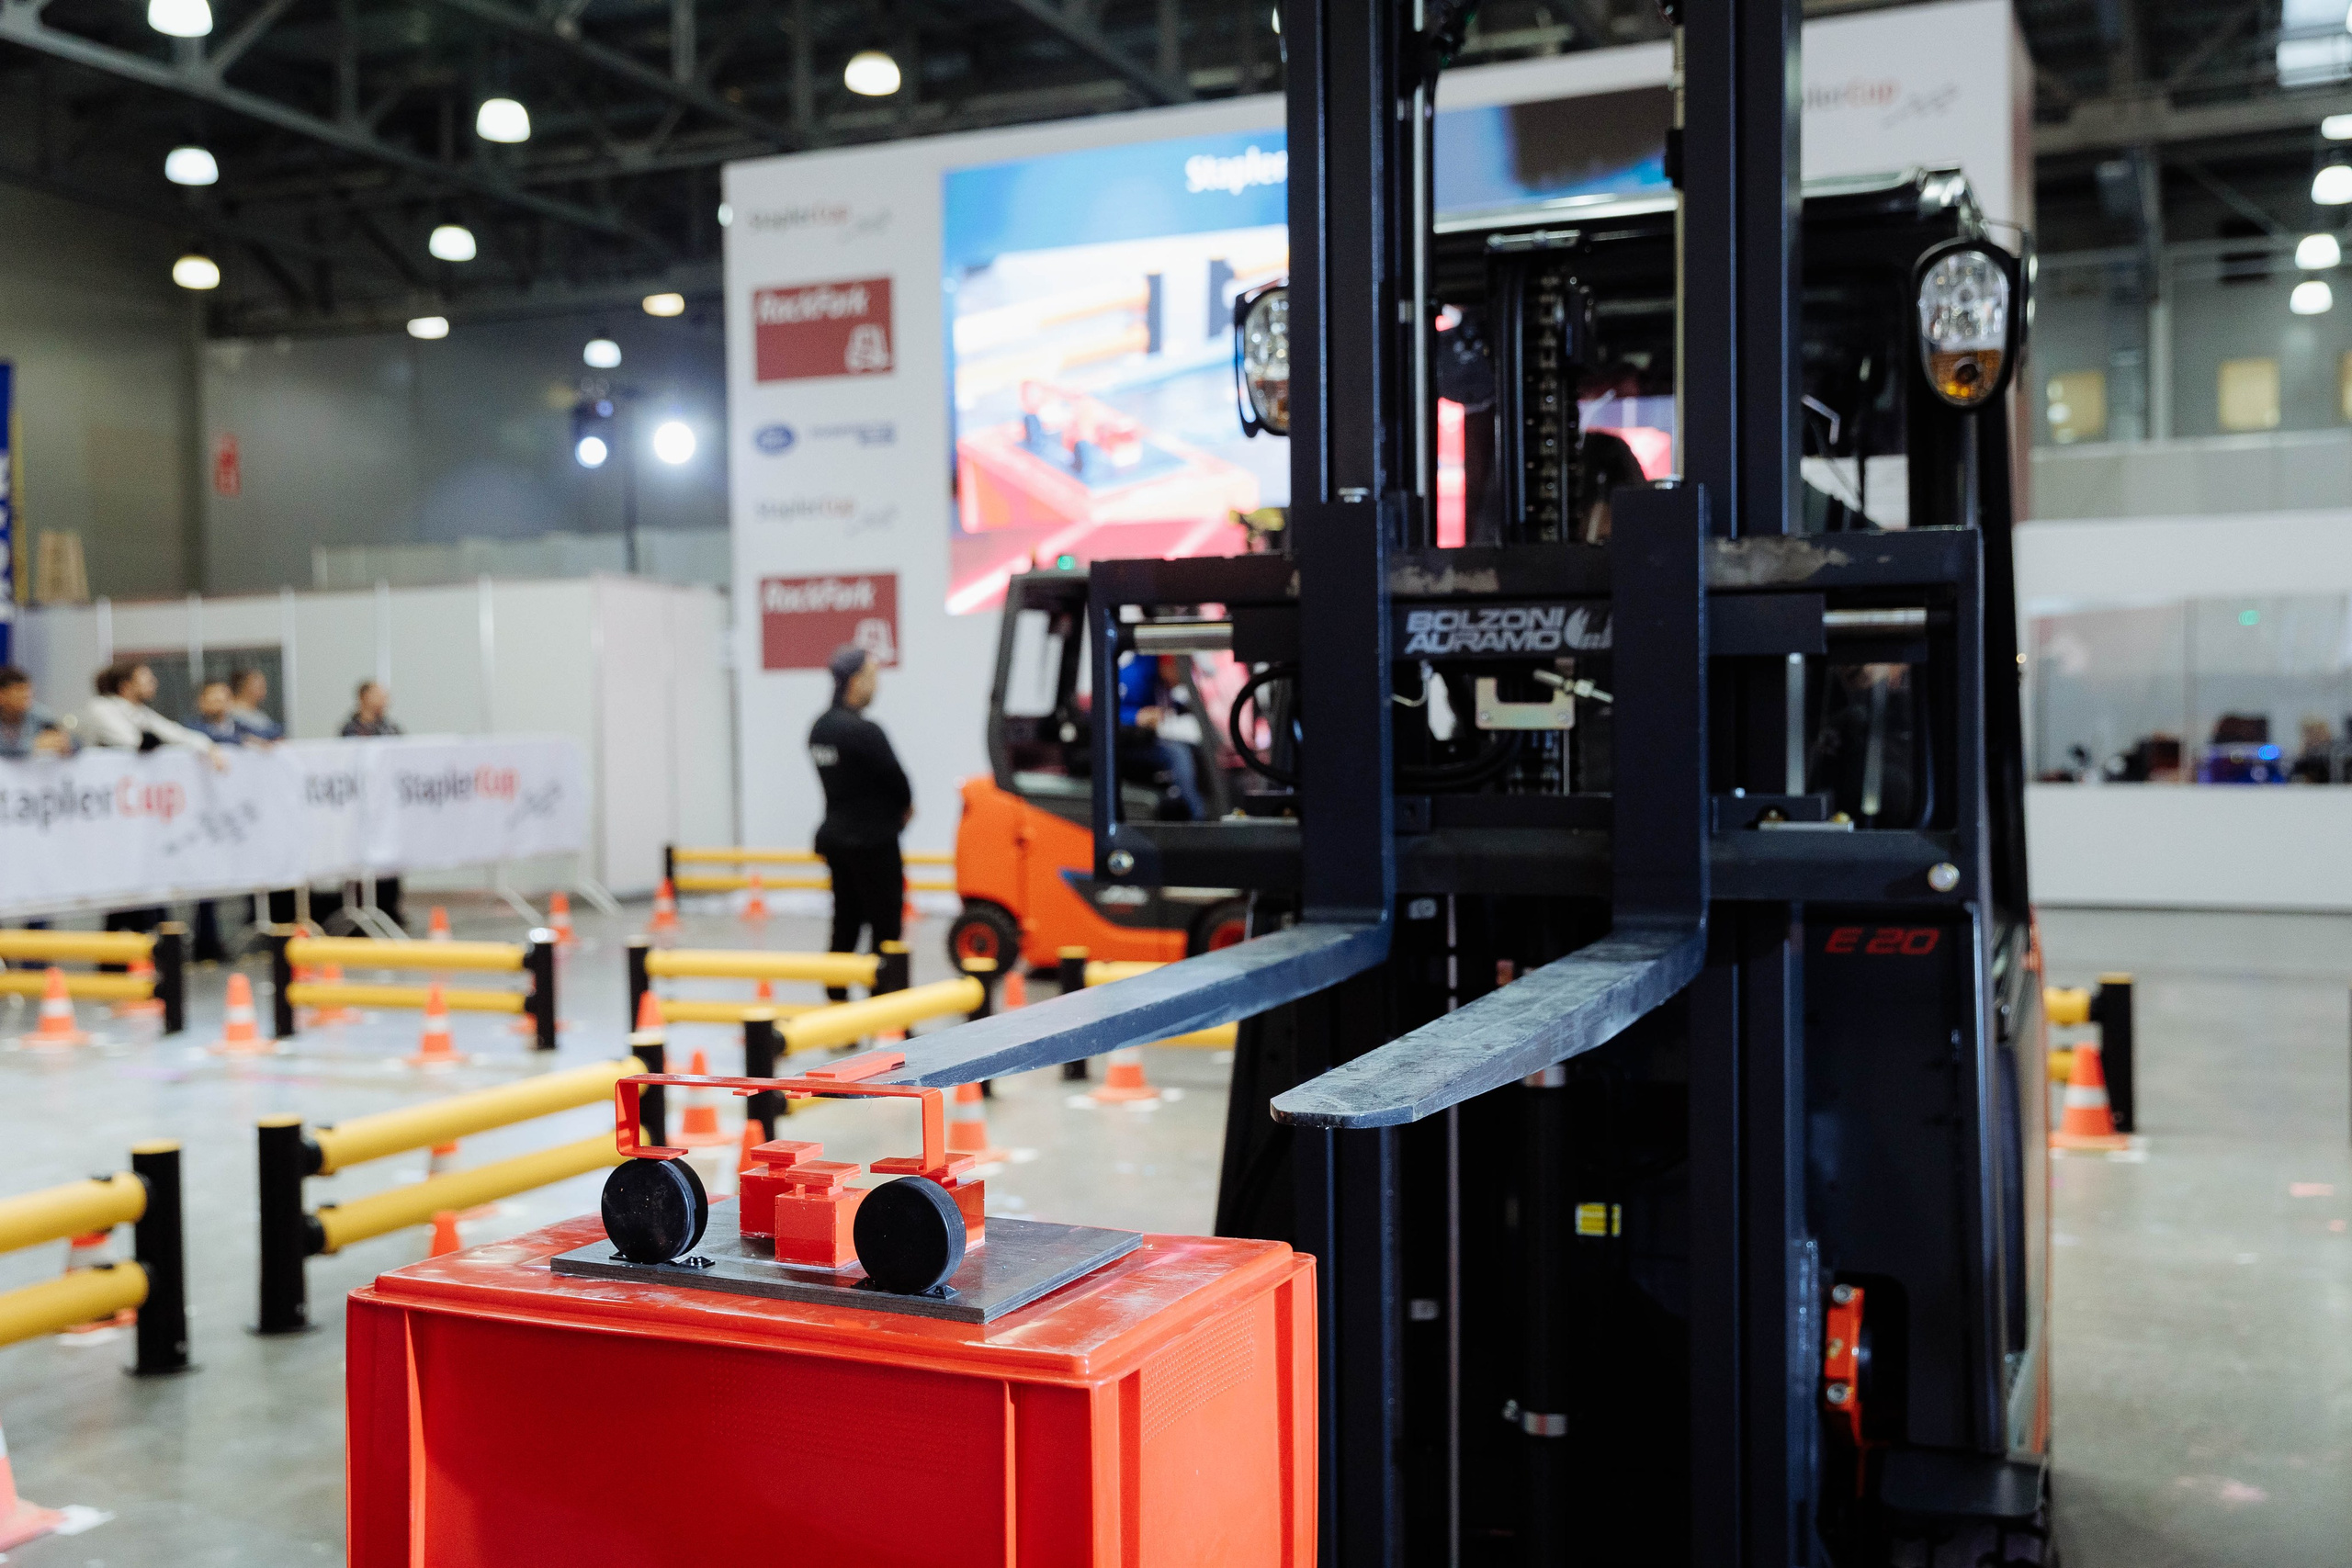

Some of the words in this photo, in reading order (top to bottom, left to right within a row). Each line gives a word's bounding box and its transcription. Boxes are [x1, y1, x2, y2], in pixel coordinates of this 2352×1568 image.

[1407, 607, 1565, 634] BOLZONI
[1404, 631, 1563, 654] AURAMO
[0, 776, 186, 835] taplerCup
[1825, 927, 1864, 954] E
[1865, 927, 1940, 955] 20
